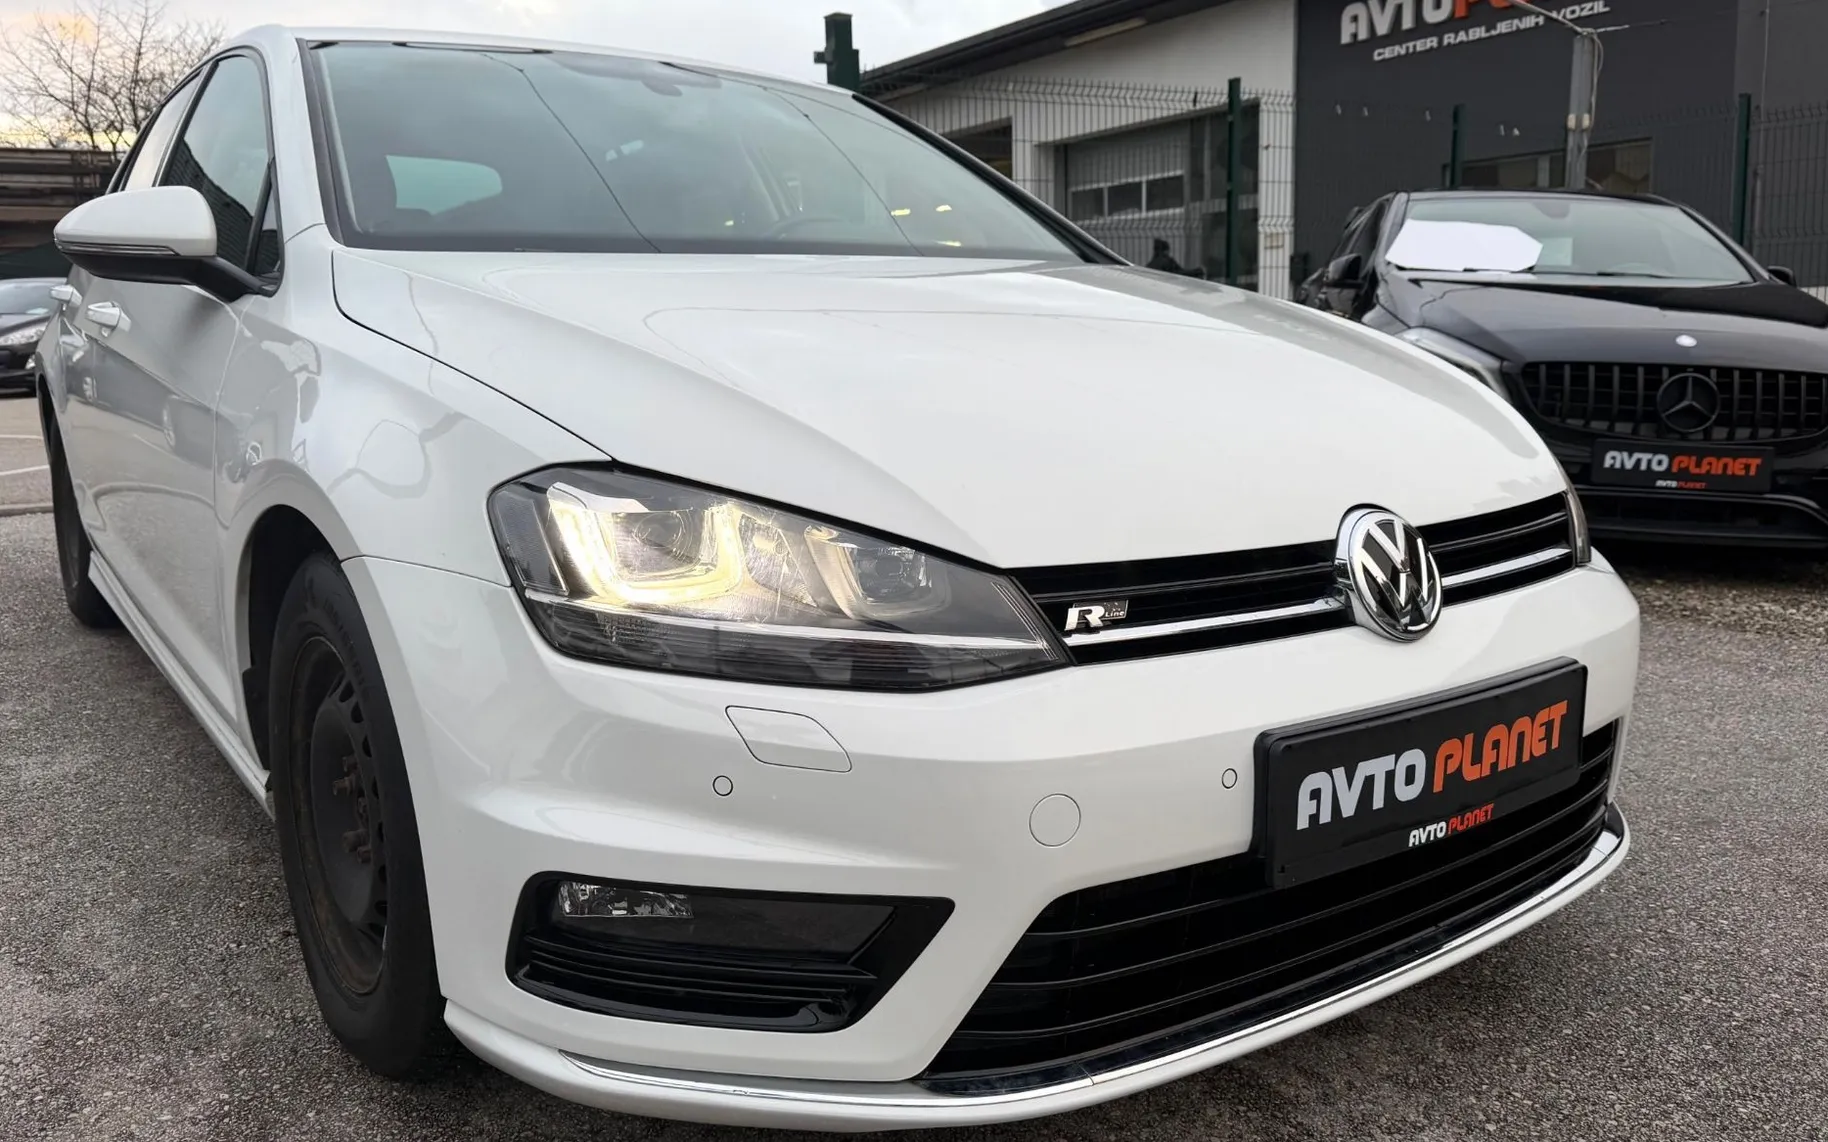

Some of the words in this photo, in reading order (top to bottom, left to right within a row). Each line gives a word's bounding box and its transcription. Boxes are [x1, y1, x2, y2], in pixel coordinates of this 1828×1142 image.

[1341, 0, 1455, 45] AVTO
[1373, 36, 1438, 61] CENTER
[1442, 14, 1545, 46] RABLJENIH
[1551, 0, 1610, 20] VOZIL
[1603, 450, 1669, 472] AVTO
[1671, 454, 1762, 476] PLANET
[1064, 606, 1105, 631] R
[1297, 748, 1427, 830] AVTO
[1433, 700, 1568, 793] PLANET
[1408, 821, 1446, 847] AVTO
[1447, 803, 1494, 835] PLANET
